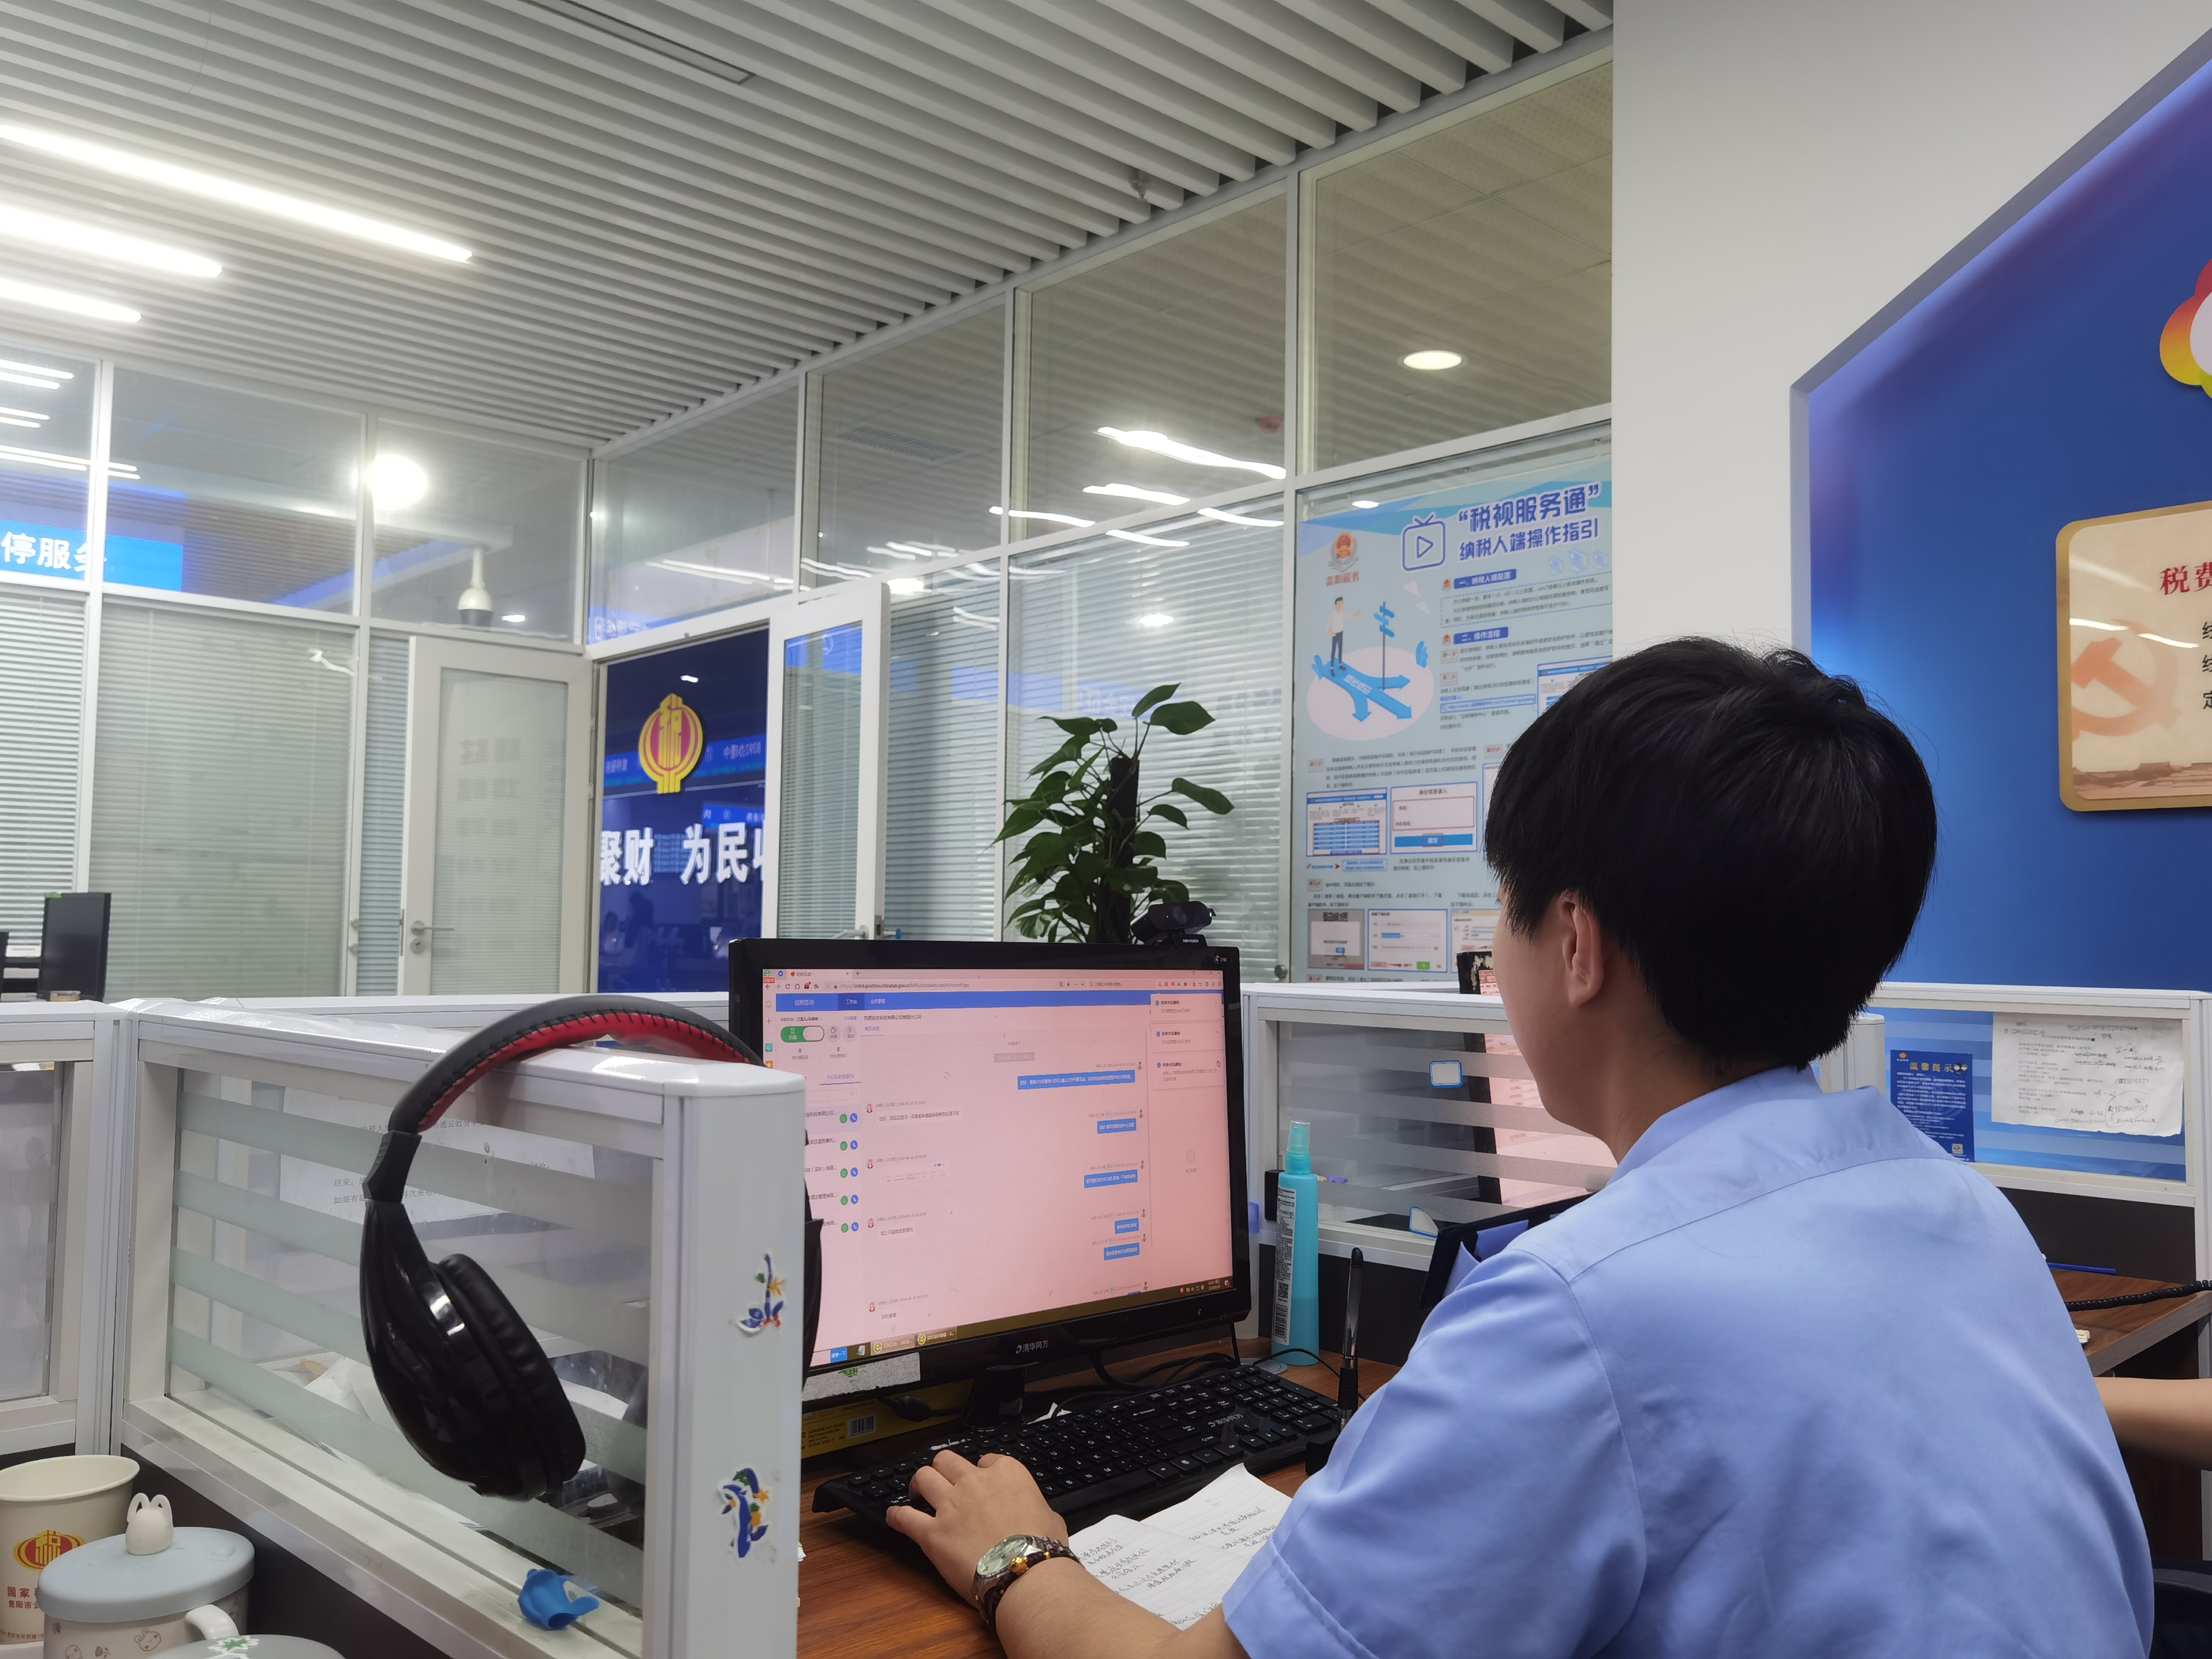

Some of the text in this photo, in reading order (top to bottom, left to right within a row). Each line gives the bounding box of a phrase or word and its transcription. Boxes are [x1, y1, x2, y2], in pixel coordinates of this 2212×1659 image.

[1459, 484, 1599, 532] “税视服务通”
[1459, 518, 1599, 561] 纳税人端操作指引
[1022, 1340, 1049, 1353] 清华同方
